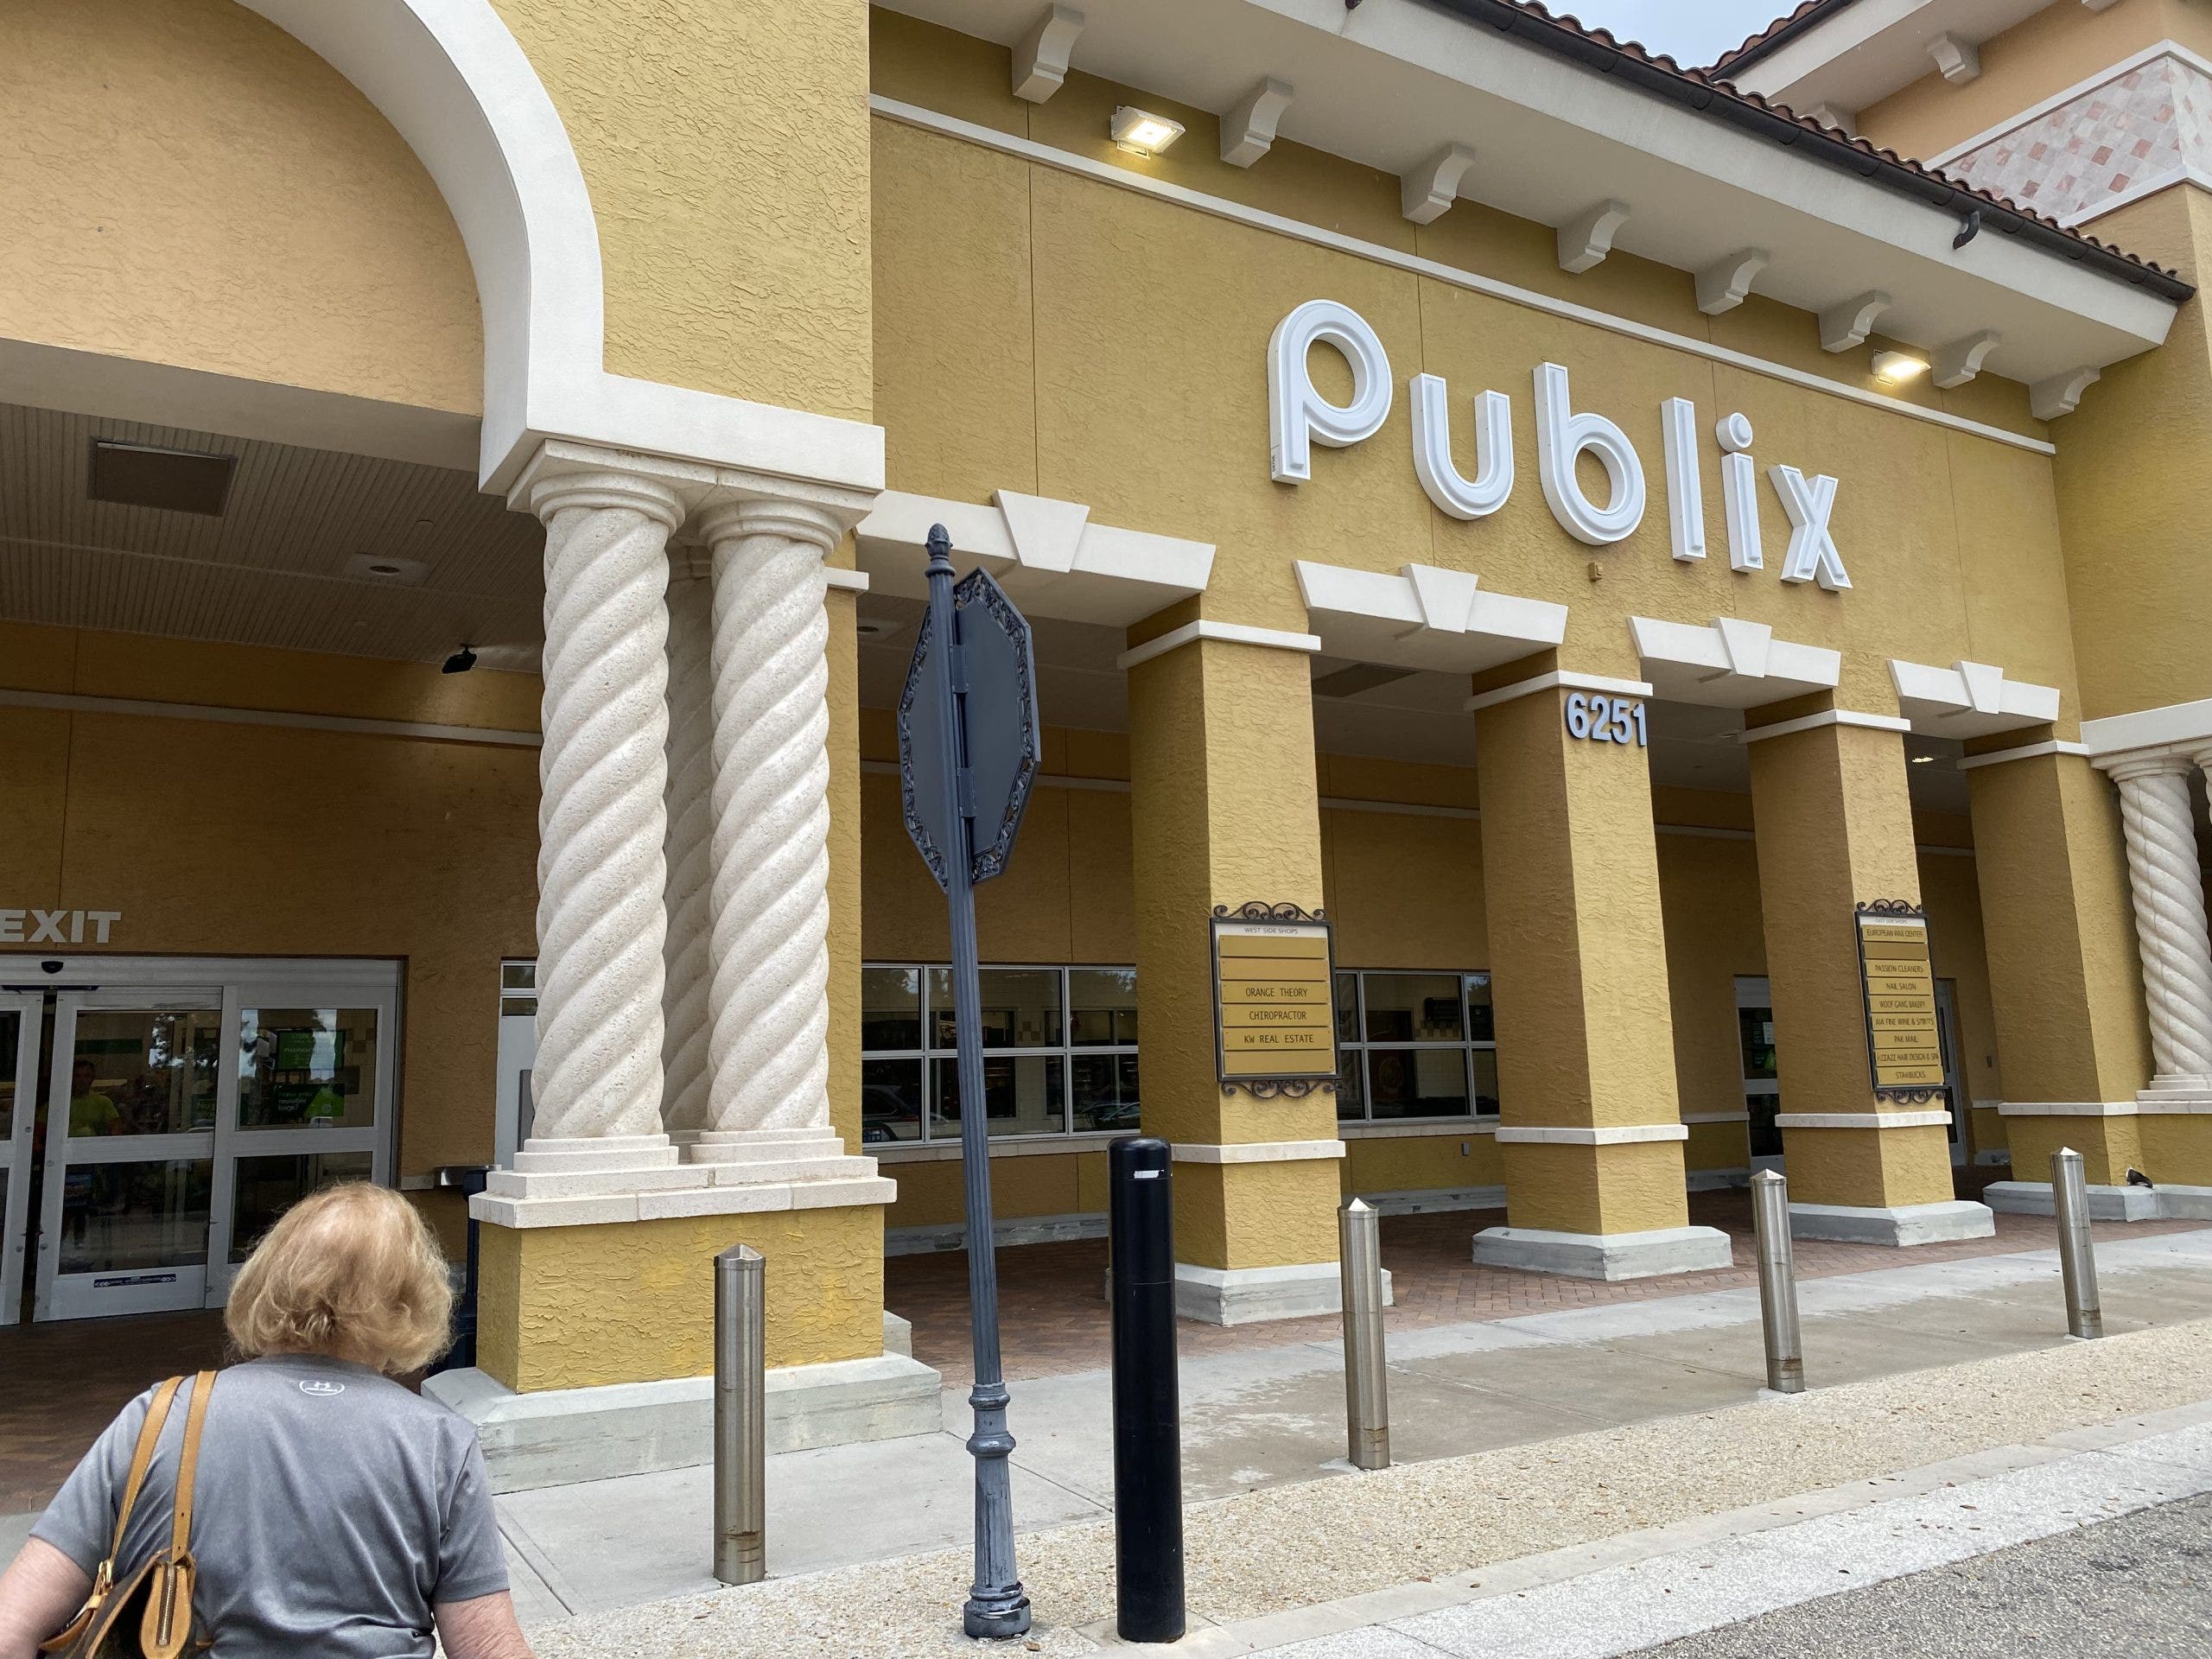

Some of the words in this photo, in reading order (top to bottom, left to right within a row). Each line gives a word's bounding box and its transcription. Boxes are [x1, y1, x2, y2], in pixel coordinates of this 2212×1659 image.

[1268, 299, 1853, 592] Publix
[1565, 692, 1647, 747] 6251
[0, 909, 122, 944] EXIT
[1866, 929, 1894, 938] EUROPEAN
[1875, 964, 1897, 973] PASSION
[1245, 987, 1275, 997] ORANGE
[1280, 988, 1308, 997] THEORY
[1249, 1010, 1307, 1020] CHIROPRACTOR
[1244, 1035, 1255, 1044] KW
[1259, 1034, 1280, 1044] REAL
[1284, 1034, 1314, 1044] ESTATE
